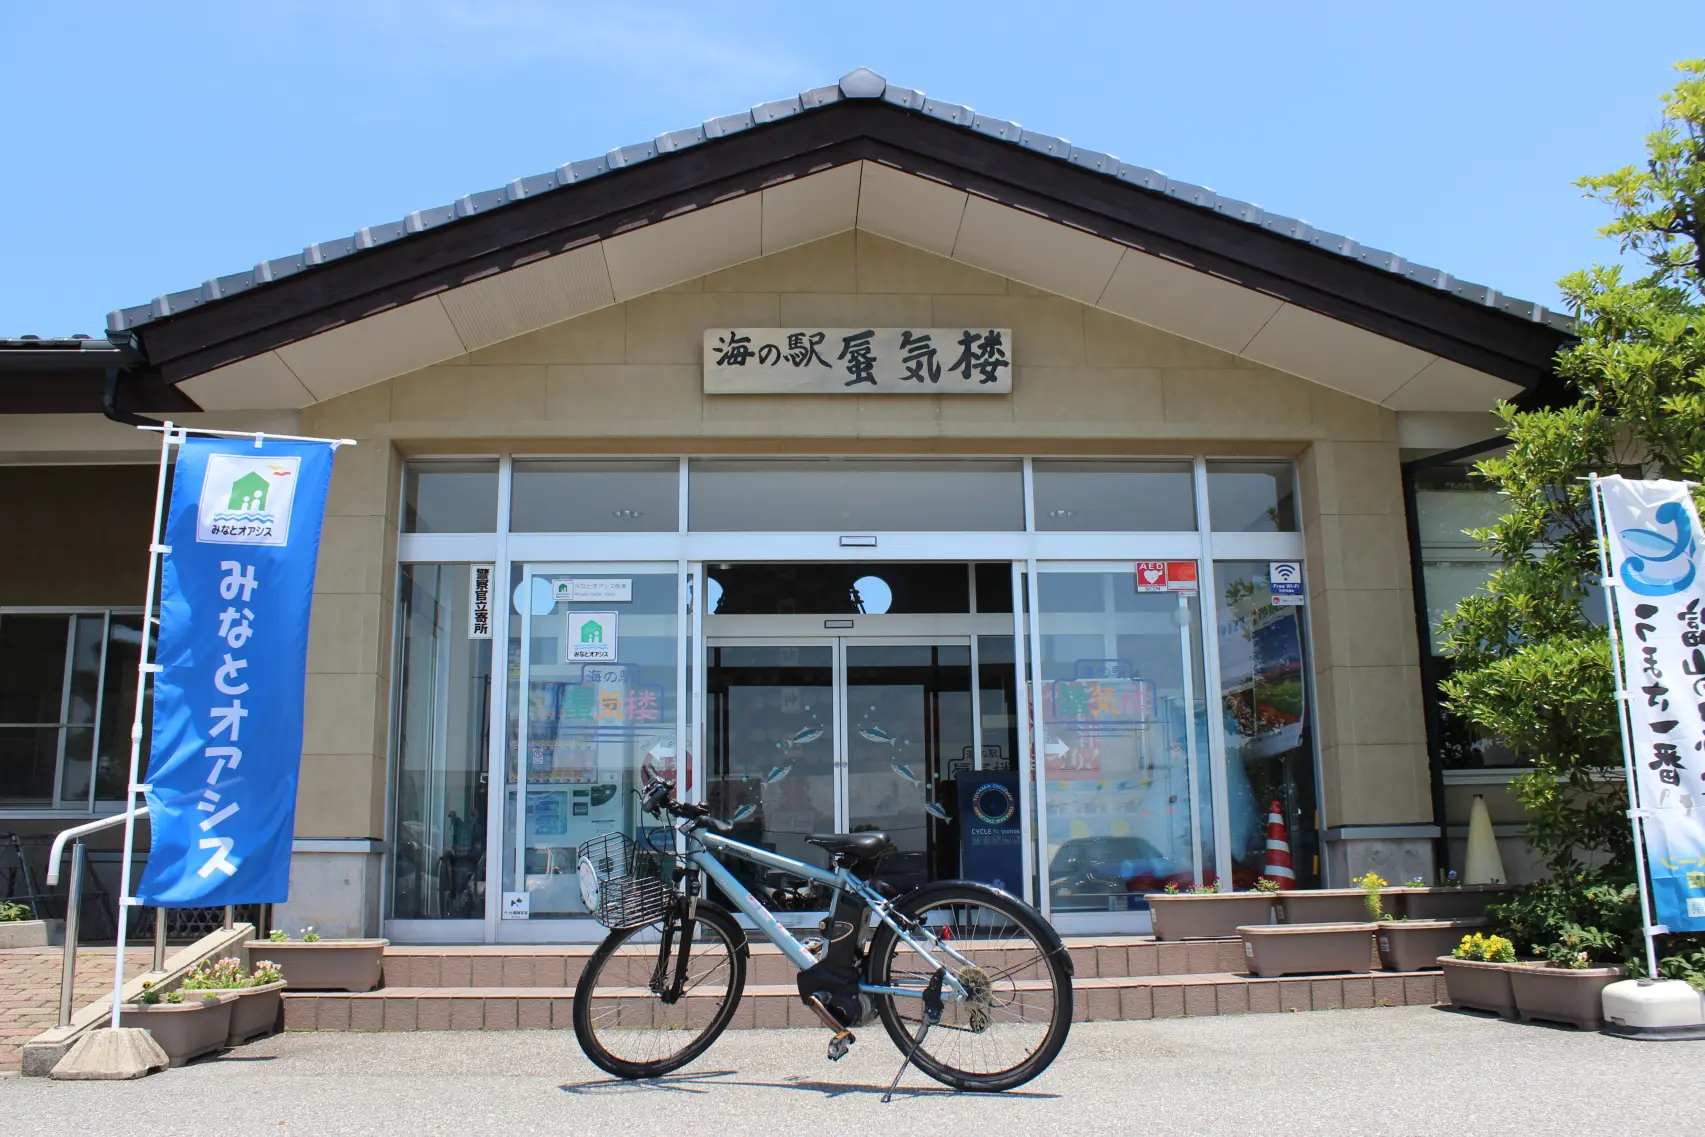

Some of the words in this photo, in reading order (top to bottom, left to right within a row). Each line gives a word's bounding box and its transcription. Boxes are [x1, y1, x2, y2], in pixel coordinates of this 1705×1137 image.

[211, 524, 273, 538] みなとオアシス
[1139, 562, 1164, 570] AED
[474, 568, 490, 635] 警察官立寄所
[197, 560, 259, 879] みなとオアシス
